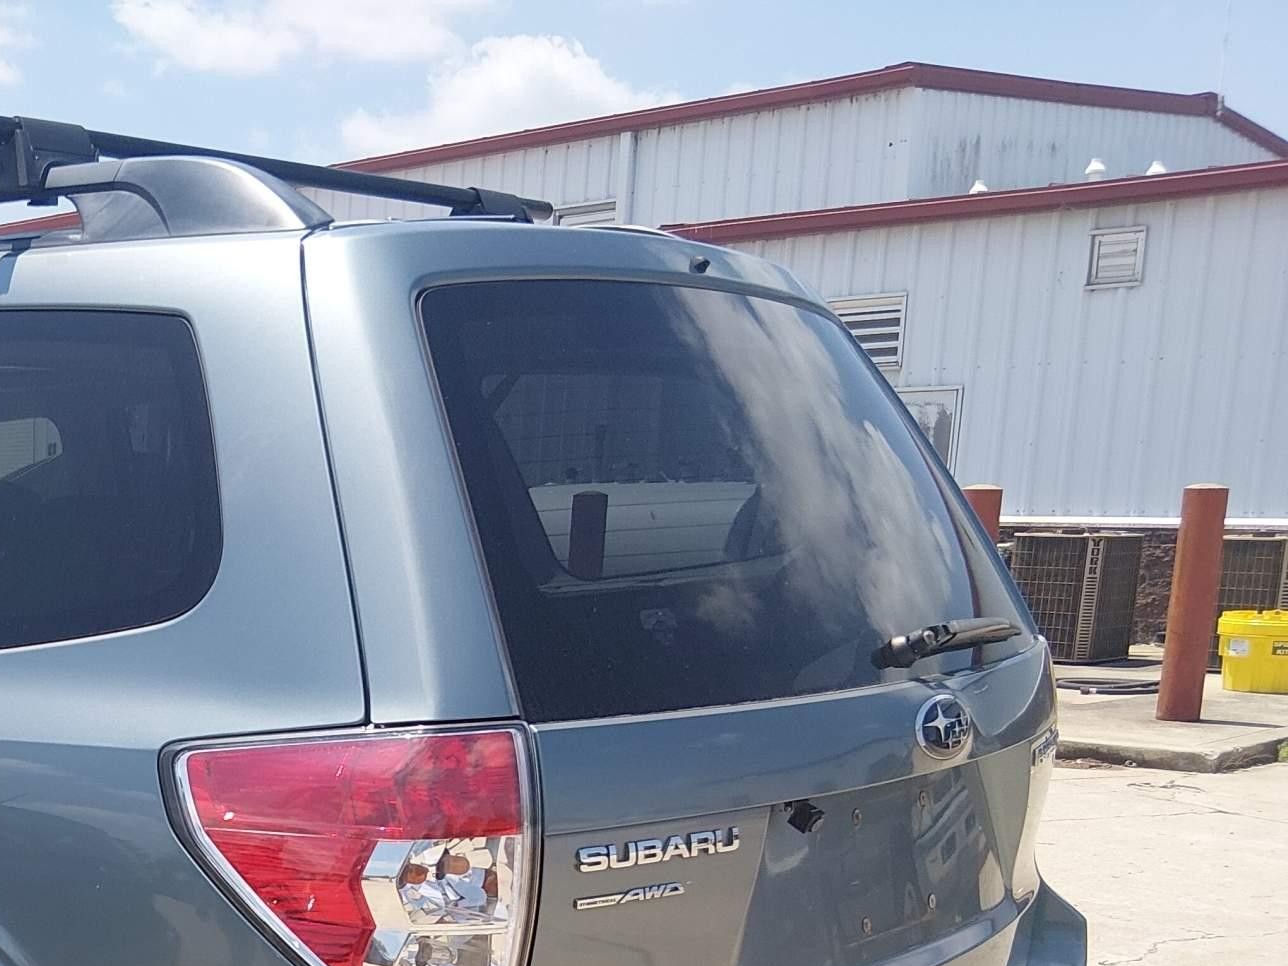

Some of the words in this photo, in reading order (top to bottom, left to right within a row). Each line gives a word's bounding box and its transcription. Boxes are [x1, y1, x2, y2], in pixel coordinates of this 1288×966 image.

[1088, 539, 1103, 576] YORK
[576, 826, 740, 873] SUBARU
[618, 881, 685, 904] AWD
